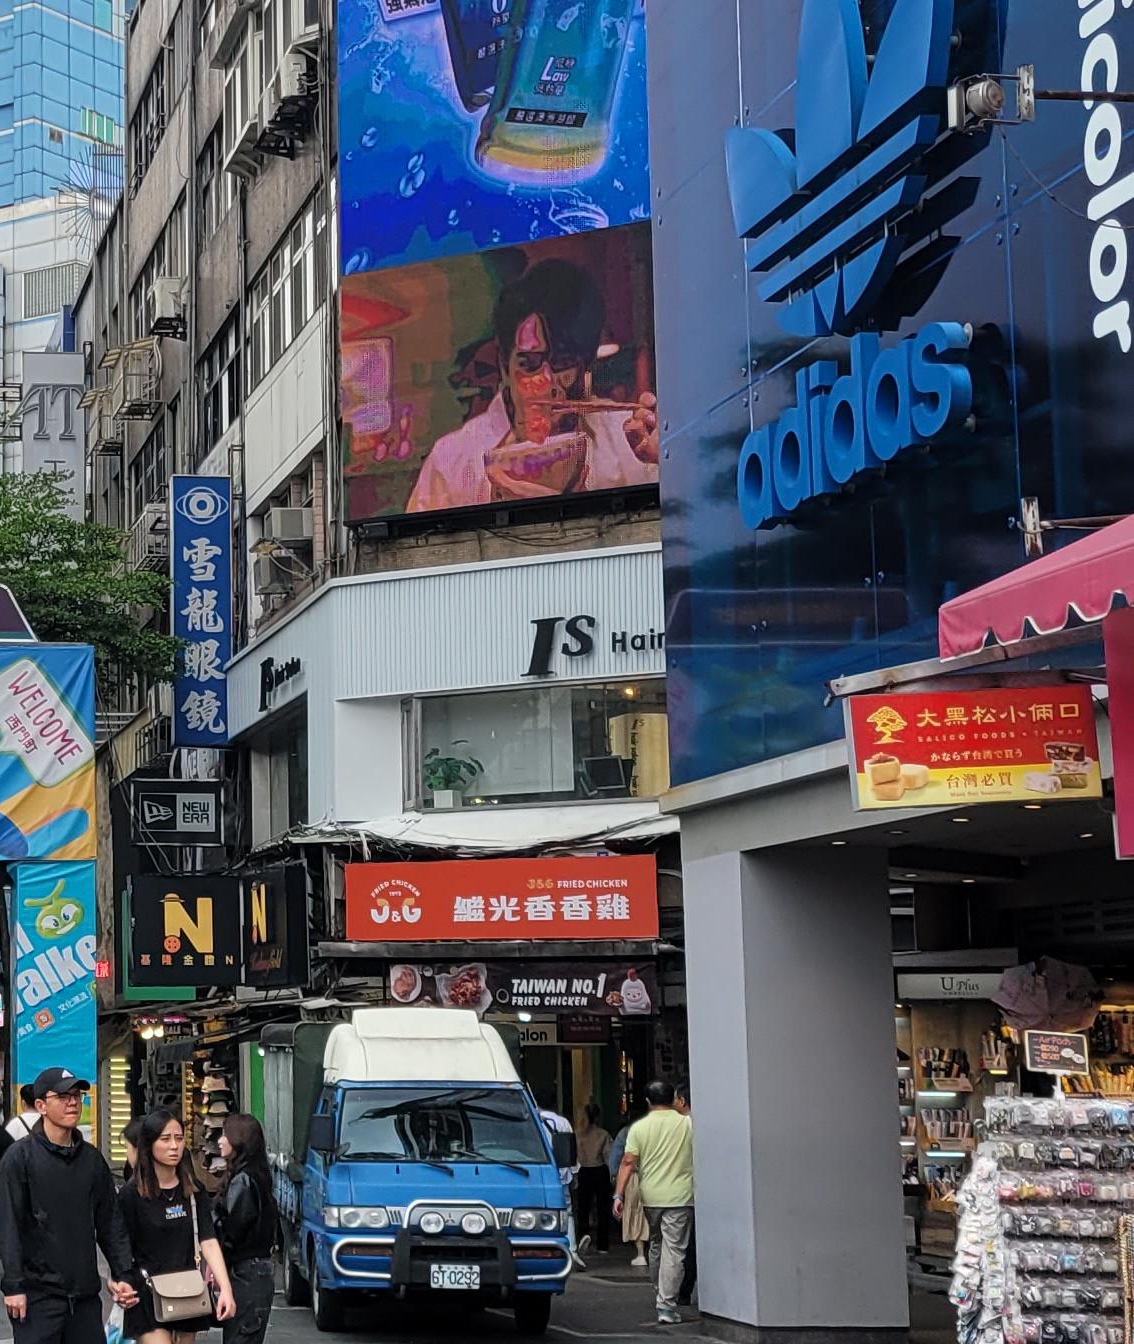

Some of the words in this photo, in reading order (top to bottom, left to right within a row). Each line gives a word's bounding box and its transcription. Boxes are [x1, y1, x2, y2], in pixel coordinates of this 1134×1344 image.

[736, 320, 973, 530] adidas
[180, 537, 227, 734] 雪龍眼鏡
[7, 670, 84, 765] WELCOME
[916, 702, 1080, 728] 大黑松小倆口
[4, 713, 39, 754] 西門町
[973, 731, 1016, 740] FOODS
[945, 770, 1014, 789] 台灣必買
[182, 801, 210, 813] NEW
[182, 813, 210, 824] ERA
[526, 878, 554, 890] J&G
[557, 879, 585, 889] FRIED
[586, 878, 628, 889] CHICKEN
[370, 897, 422, 924] J&G
[453, 893, 631, 923] 繼光香香雞
[163, 897, 214, 953] N
[511, 977, 568, 995] TAIWAN
[571, 972, 607, 998] NO.1
[940, 977, 955, 991] U
[511, 995, 541, 1006] FRIED
[544, 995, 589, 1006] CHICKEN
